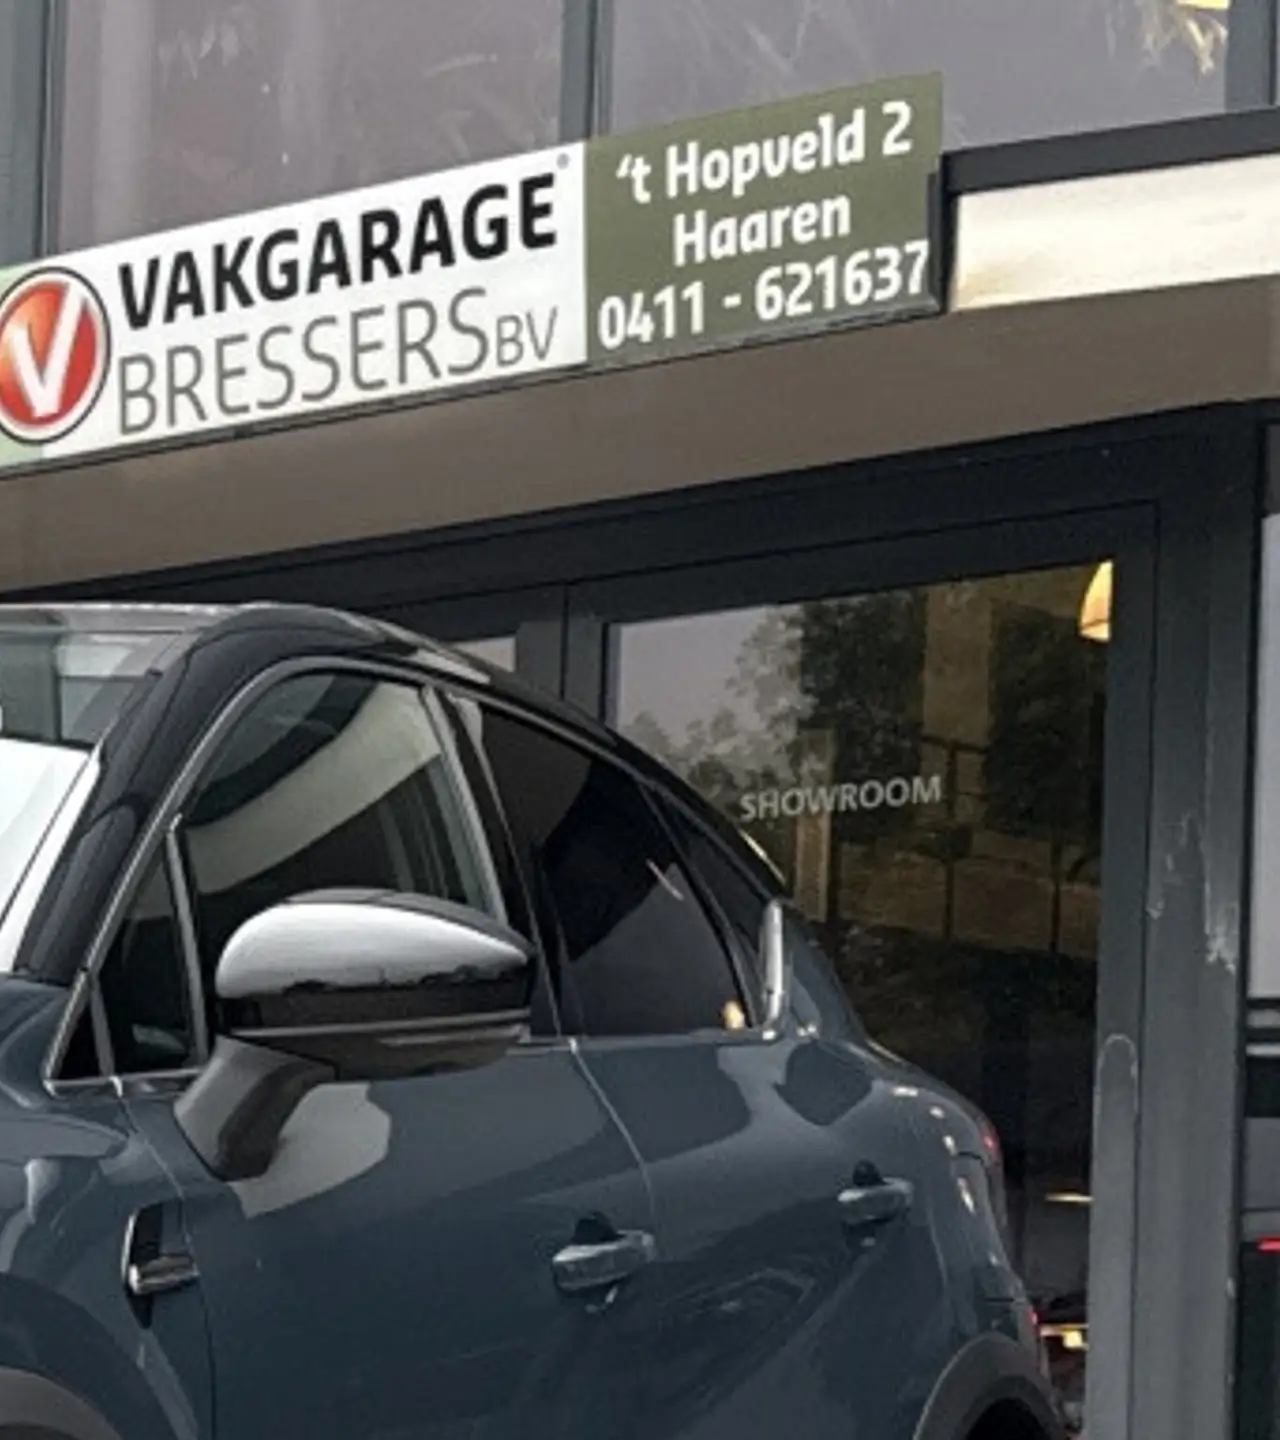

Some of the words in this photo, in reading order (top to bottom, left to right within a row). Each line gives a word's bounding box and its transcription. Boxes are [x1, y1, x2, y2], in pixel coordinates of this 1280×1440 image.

[665, 106, 867, 198] Hopveld
[881, 100, 914, 156] 2
[118, 172, 557, 330] VAKGARAGE
[673, 194, 850, 267] Haaren
[597, 280, 705, 350] 0411
[754, 239, 930, 322] 621637
[741, 774, 942, 822] SHOWROOM
